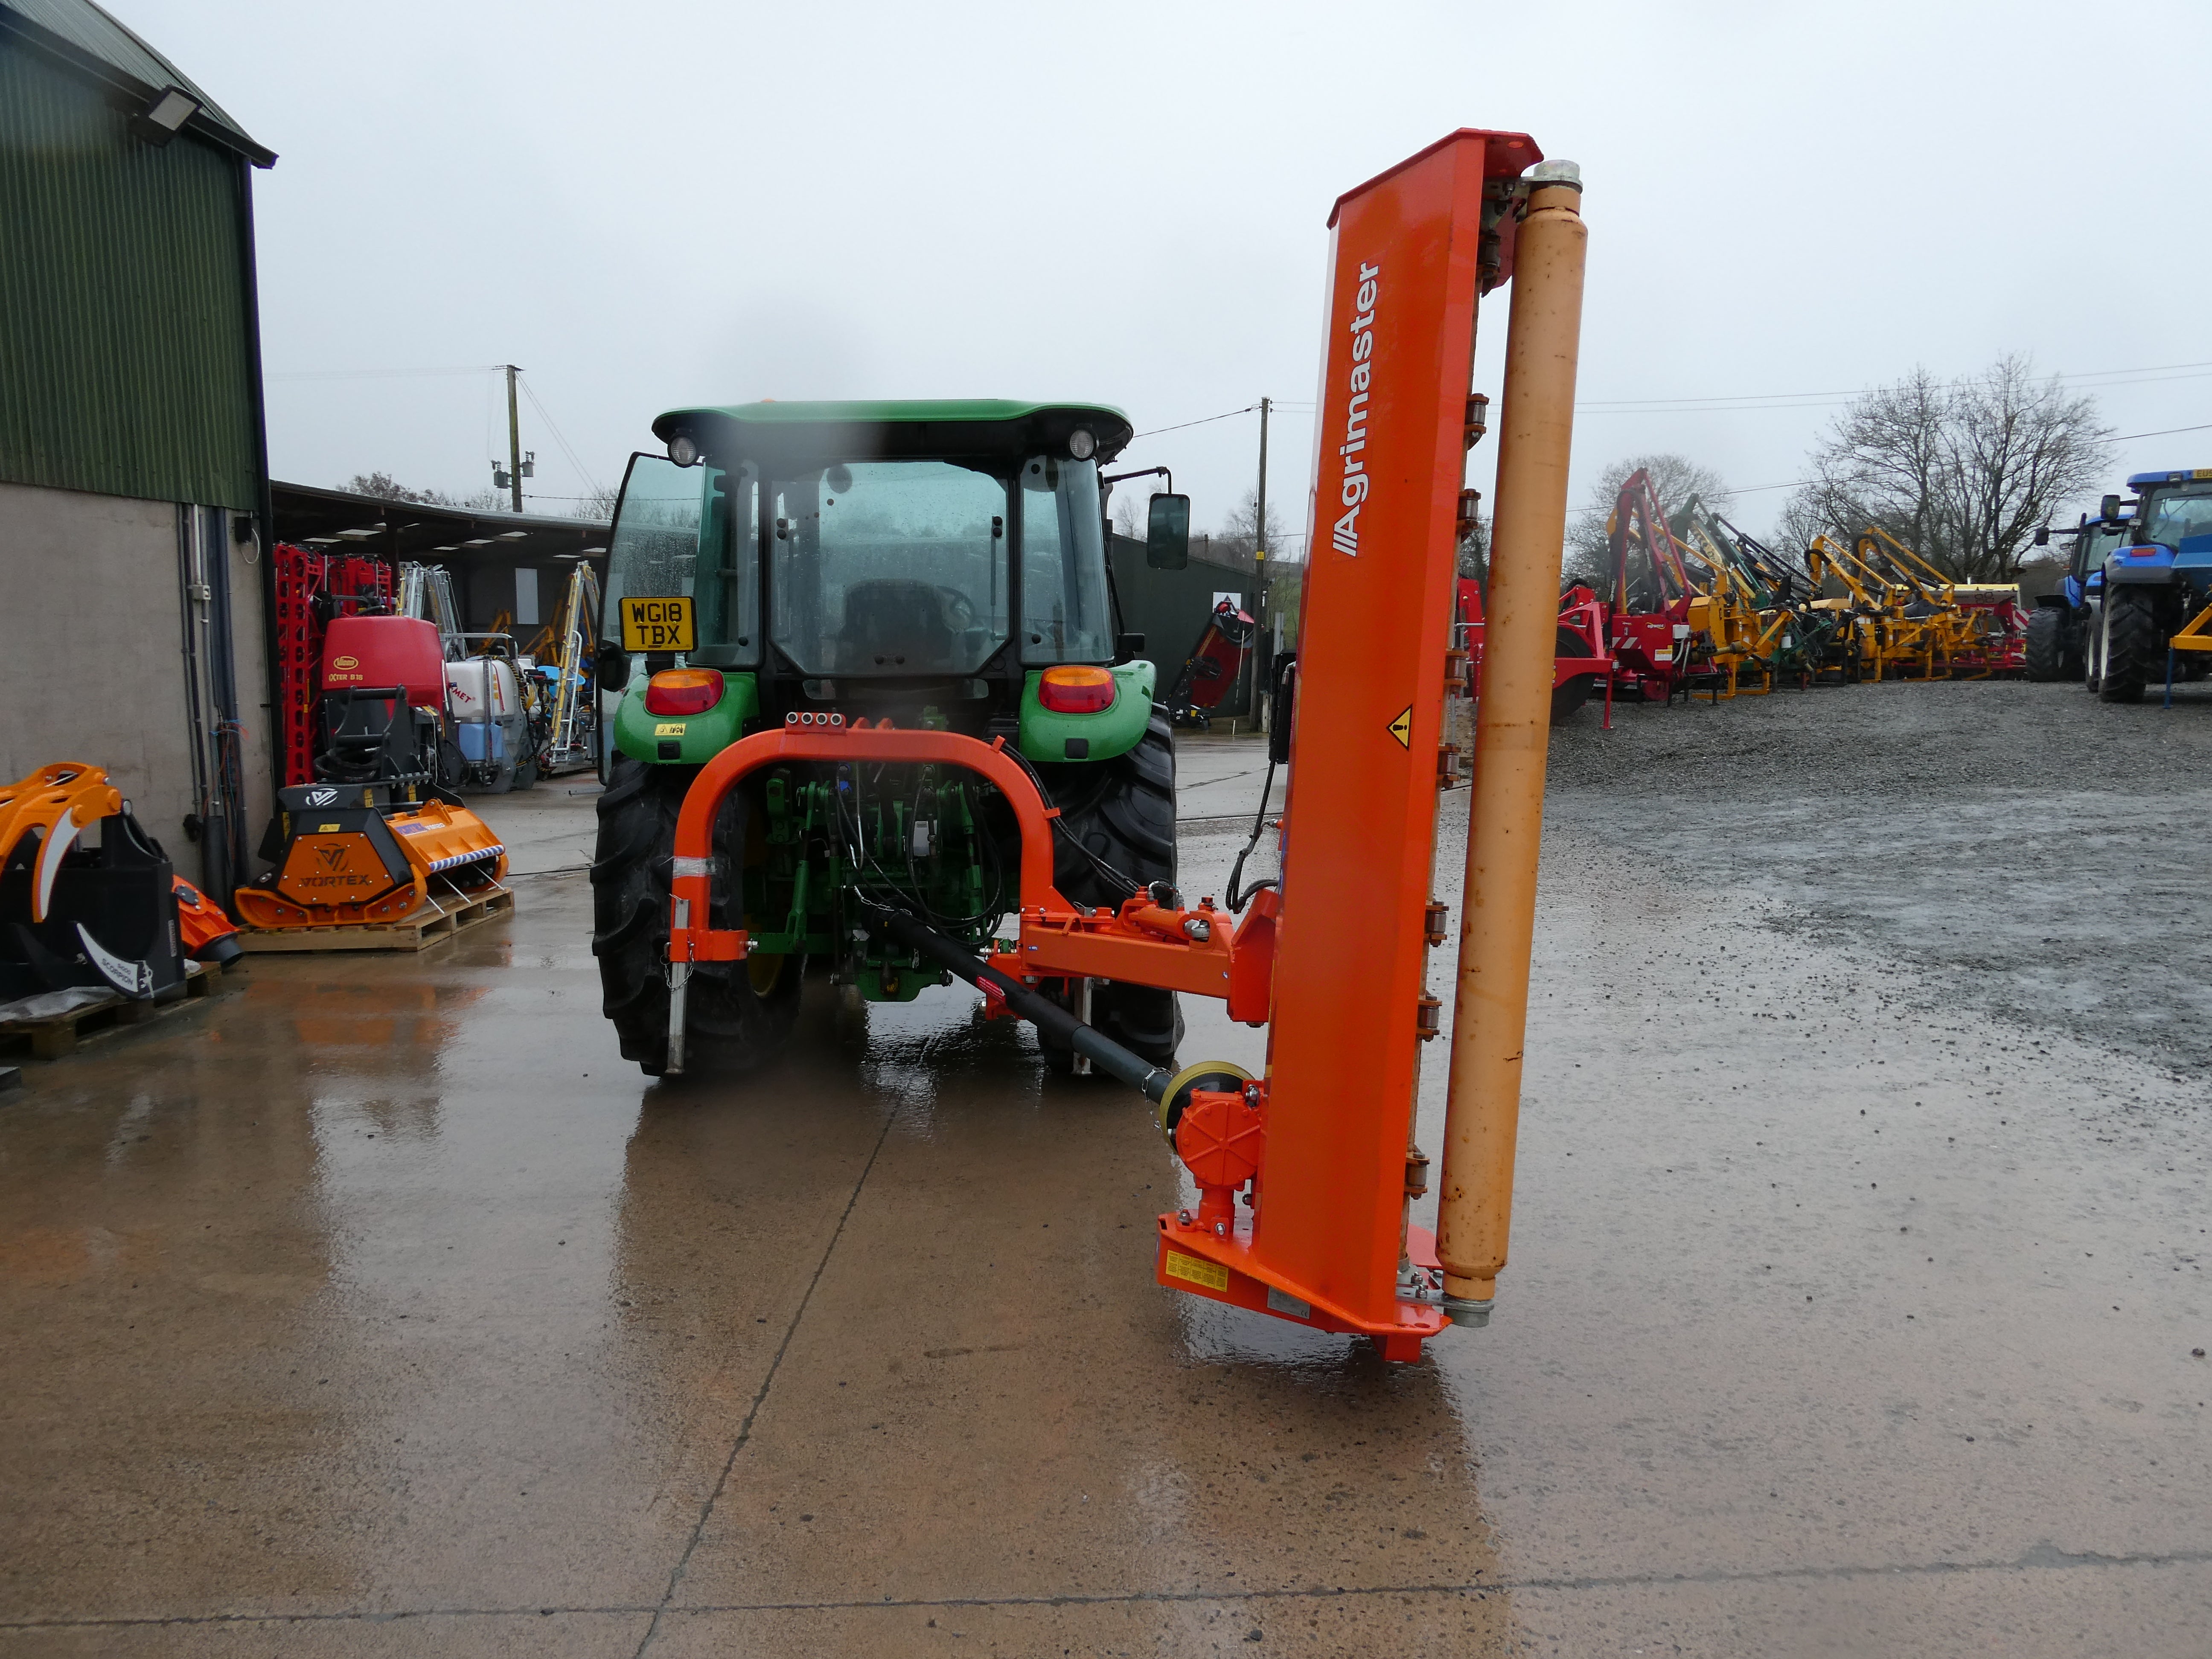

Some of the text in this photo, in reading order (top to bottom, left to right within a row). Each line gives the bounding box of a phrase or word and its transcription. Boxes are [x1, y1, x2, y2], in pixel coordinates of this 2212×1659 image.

[1334, 262, 1379, 541] Agrimaster
[632, 603, 682, 622] WG18
[636, 626, 681, 644] TBX
[450, 687, 472, 703] MET
[300, 874, 369, 888] VORTEX
